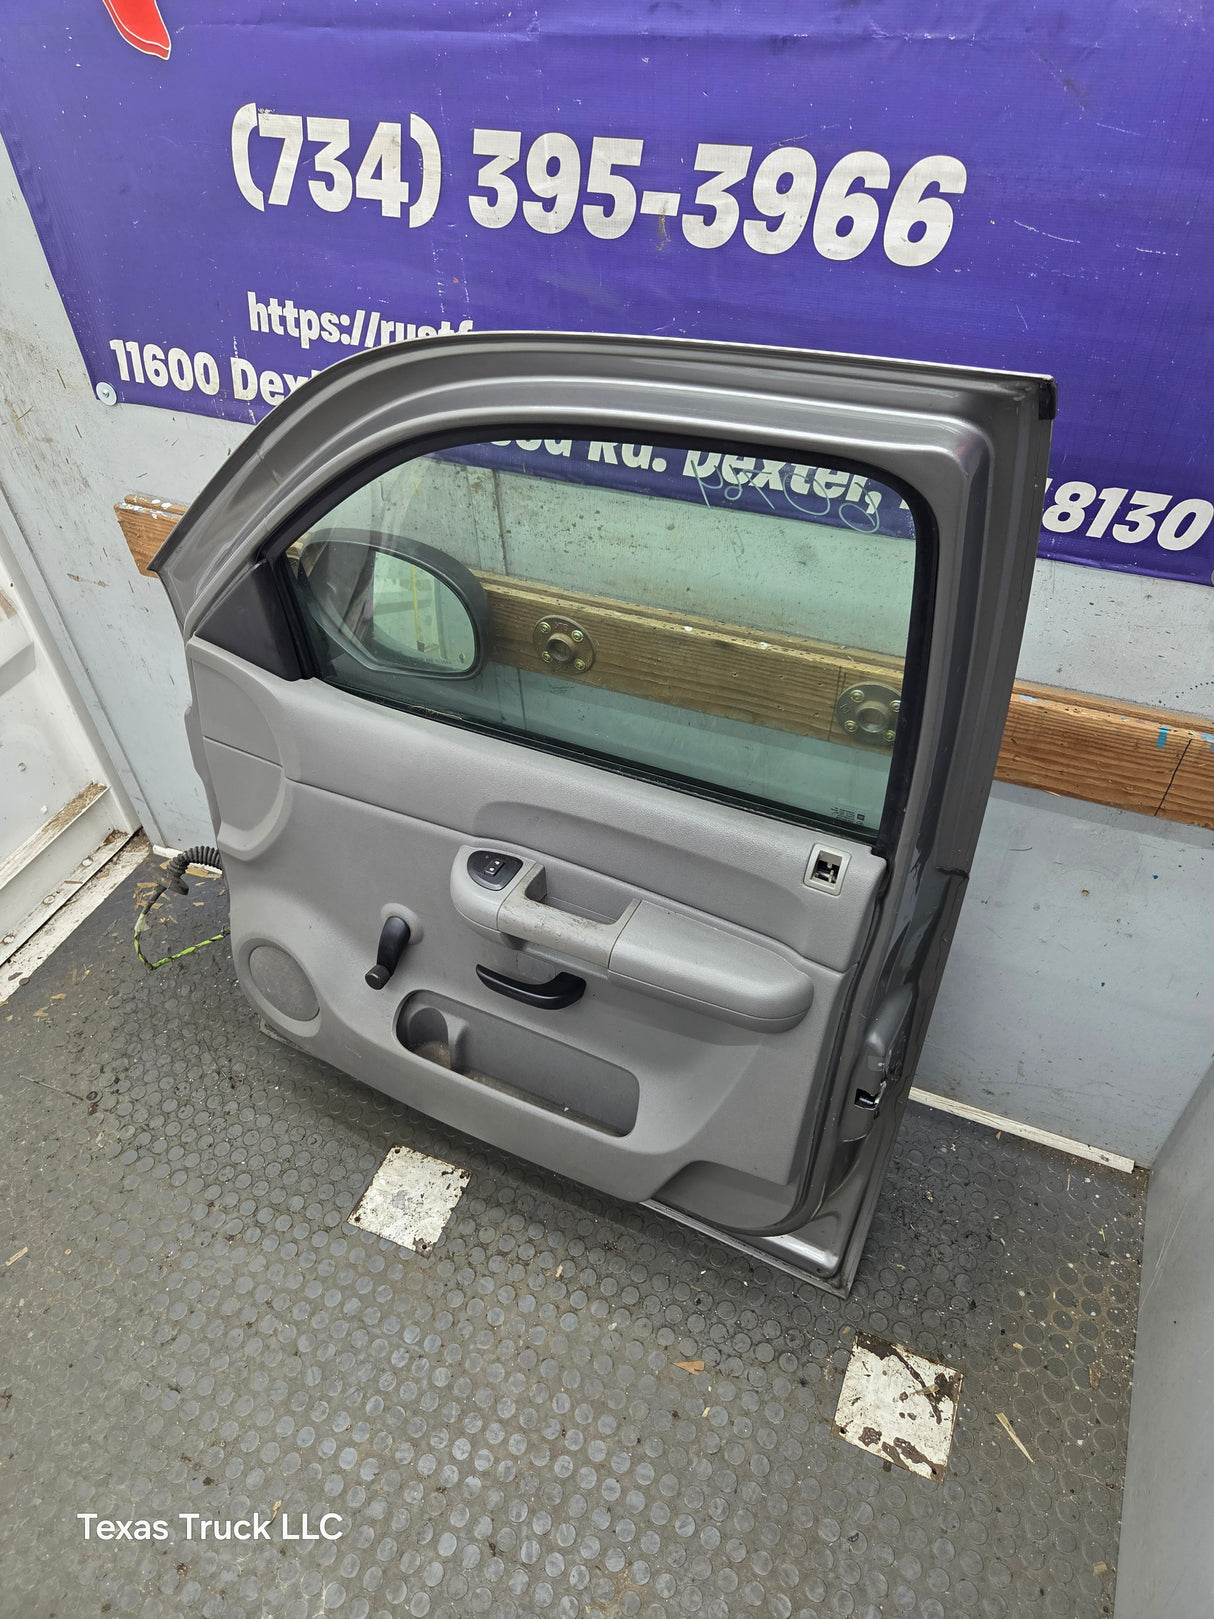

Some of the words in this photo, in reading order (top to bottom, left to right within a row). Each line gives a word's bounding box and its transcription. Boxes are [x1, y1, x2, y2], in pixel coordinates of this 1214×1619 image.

[231, 102, 442, 229] (734)
[468, 128, 967, 267] 395-3966
[109, 339, 220, 396] 11600
[230, 356, 322, 406] Dex
[1042, 477, 1214, 551] 8130
